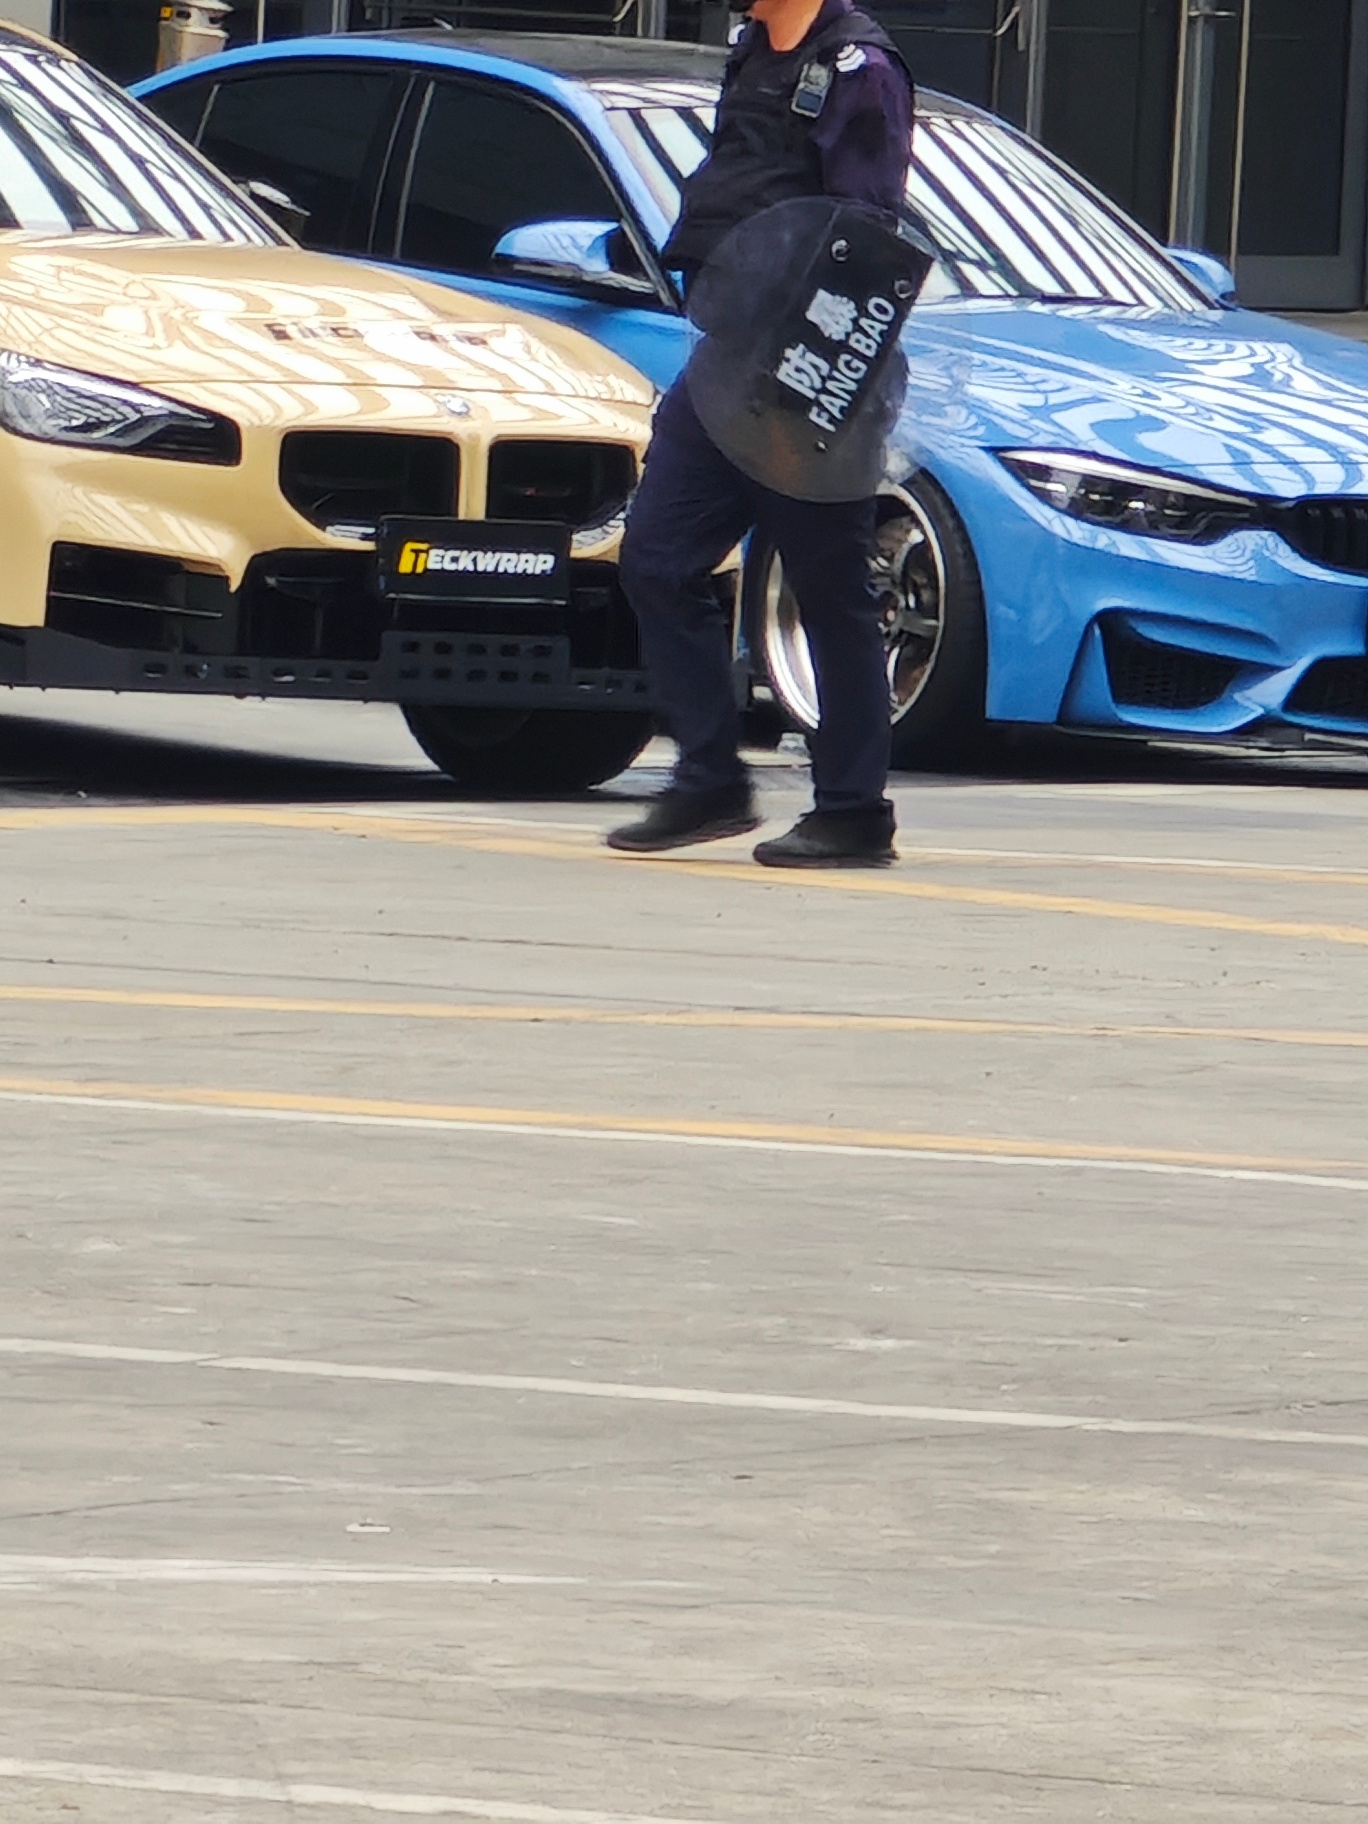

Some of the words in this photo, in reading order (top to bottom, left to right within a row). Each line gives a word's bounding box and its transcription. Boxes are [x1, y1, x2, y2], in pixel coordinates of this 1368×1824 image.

[775, 288, 858, 399] 防暴
[808, 344, 868, 433] FANG
[848, 295, 895, 359] BAO
[397, 541, 556, 575] TECKWRAP
